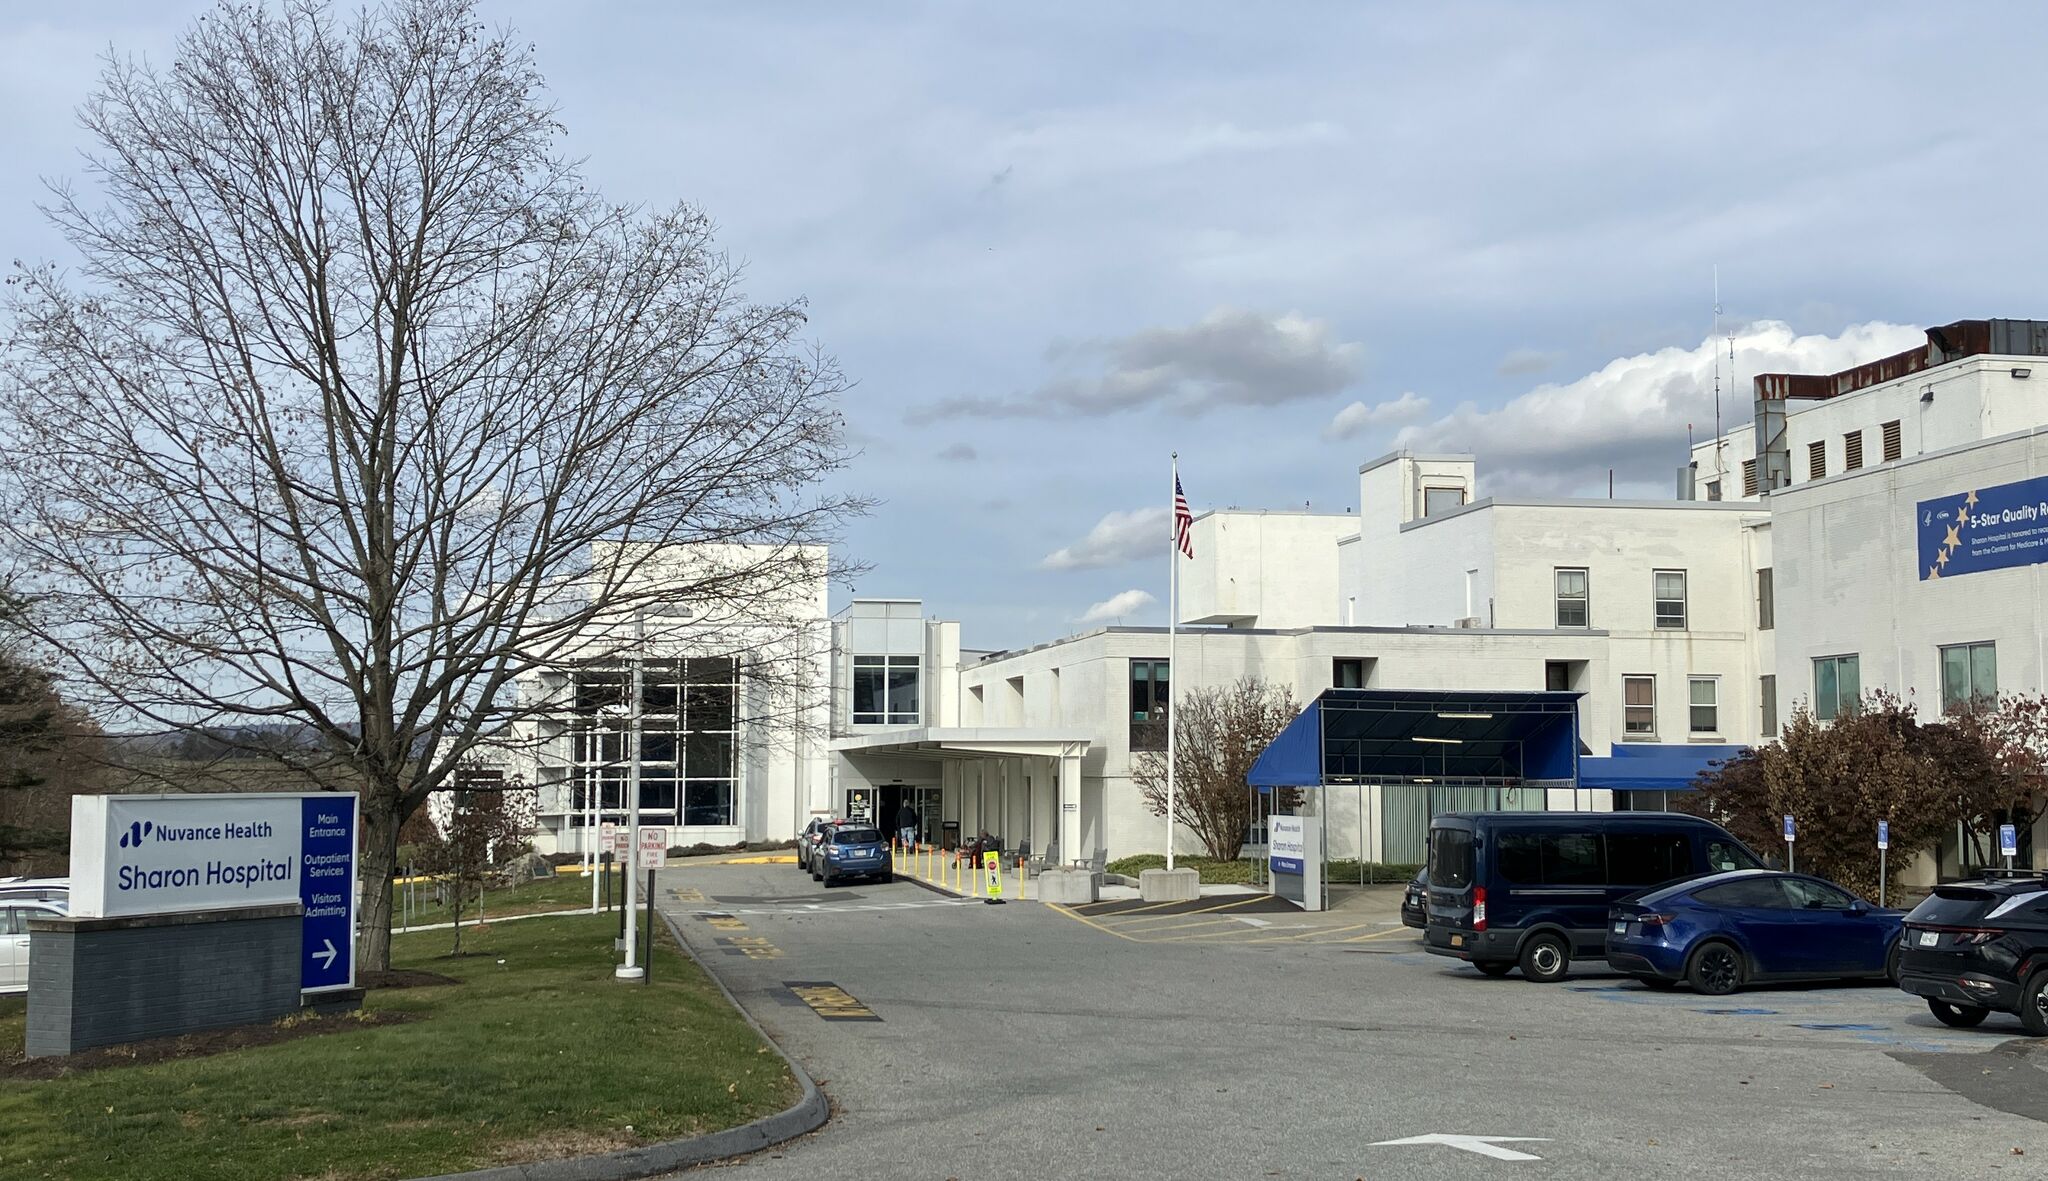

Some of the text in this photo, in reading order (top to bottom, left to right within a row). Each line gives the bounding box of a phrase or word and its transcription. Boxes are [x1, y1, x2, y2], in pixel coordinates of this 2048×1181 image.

[1971, 513, 2000, 528] 5-Star
[2002, 505, 2037, 522] Quality
[2017, 540, 2038, 549] Medicare
[318, 814, 338, 824] Main
[156, 821, 272, 842] Nuvance Health
[309, 827, 346, 838] Entrance
[648, 832, 658, 840] NO
[304, 853, 350, 866] Outpatient
[118, 856, 292, 891] Sharon Hospital
[310, 866, 344, 877] Services
[312, 893, 341, 904] Visitors
[305, 905, 346, 918] Admitting
